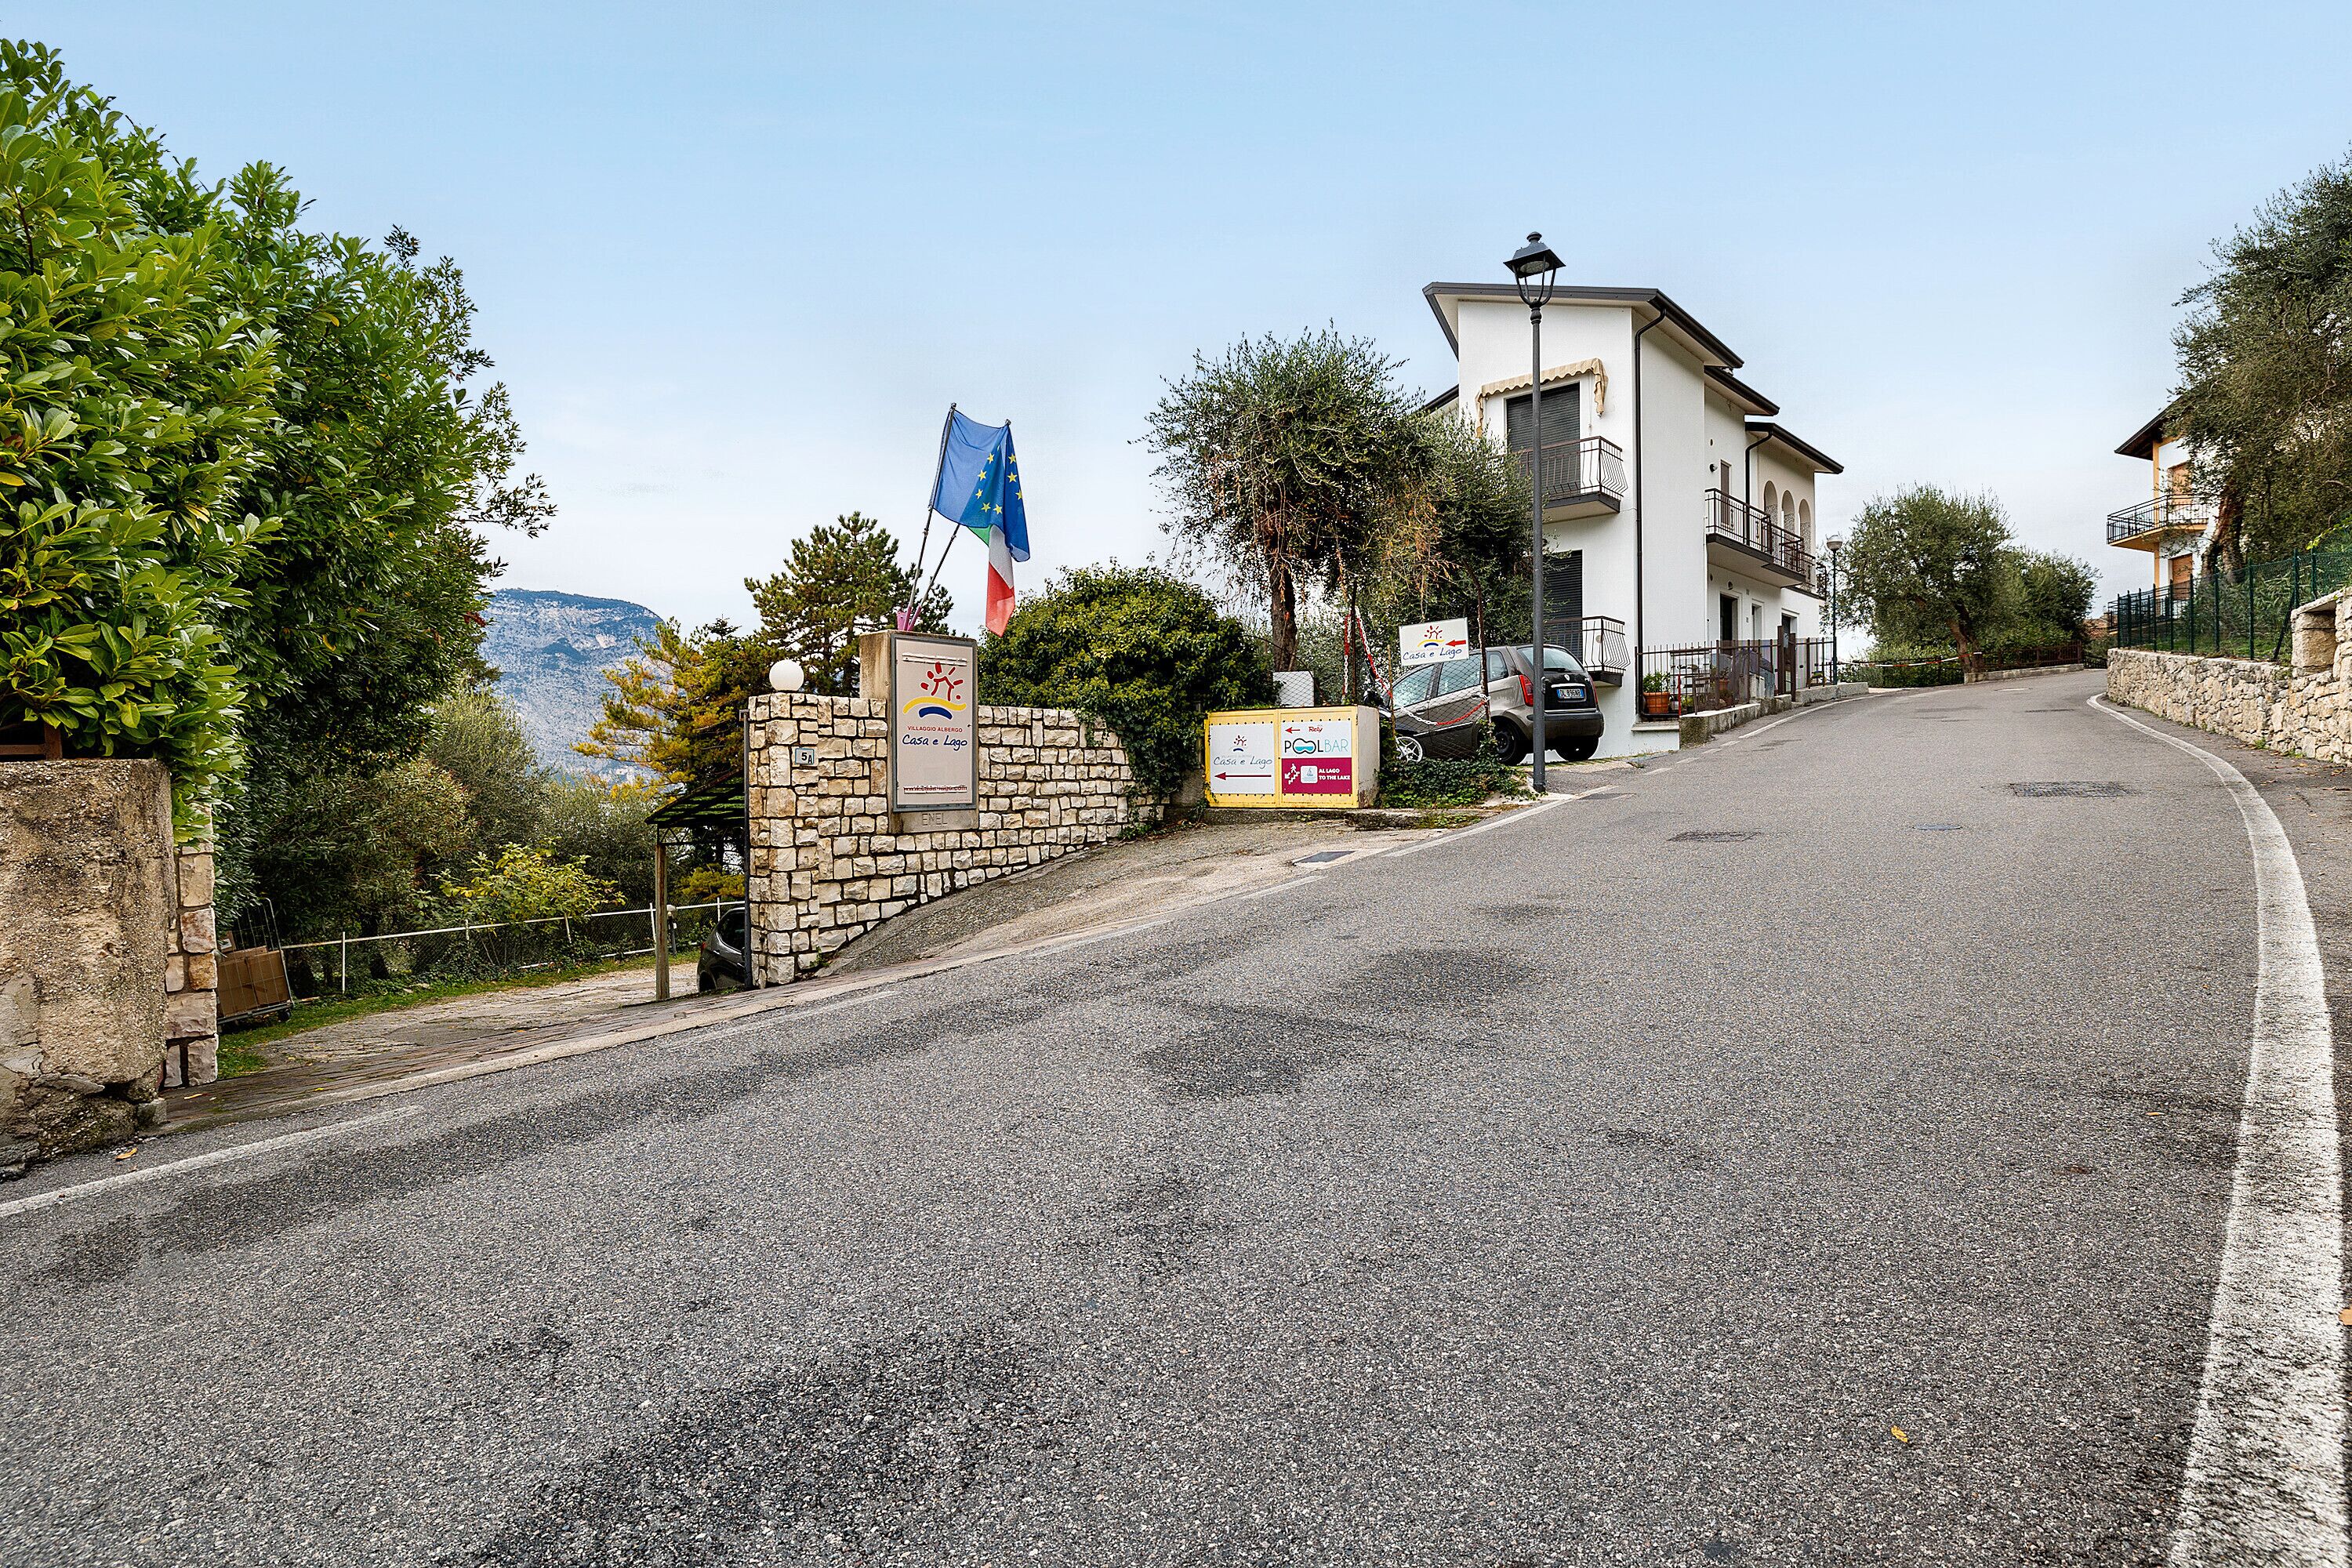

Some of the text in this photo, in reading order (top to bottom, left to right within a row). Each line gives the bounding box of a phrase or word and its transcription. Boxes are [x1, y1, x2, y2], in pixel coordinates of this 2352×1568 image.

[1403, 652, 1425, 661] Casa
[1439, 648, 1462, 659] Lago
[902, 734, 929, 746] Casa
[943, 735, 967, 751] Lago
[1213, 756, 1237, 766] Casa
[1250, 756, 1272, 769] Lago
[921, 812, 948, 826] ENEL
